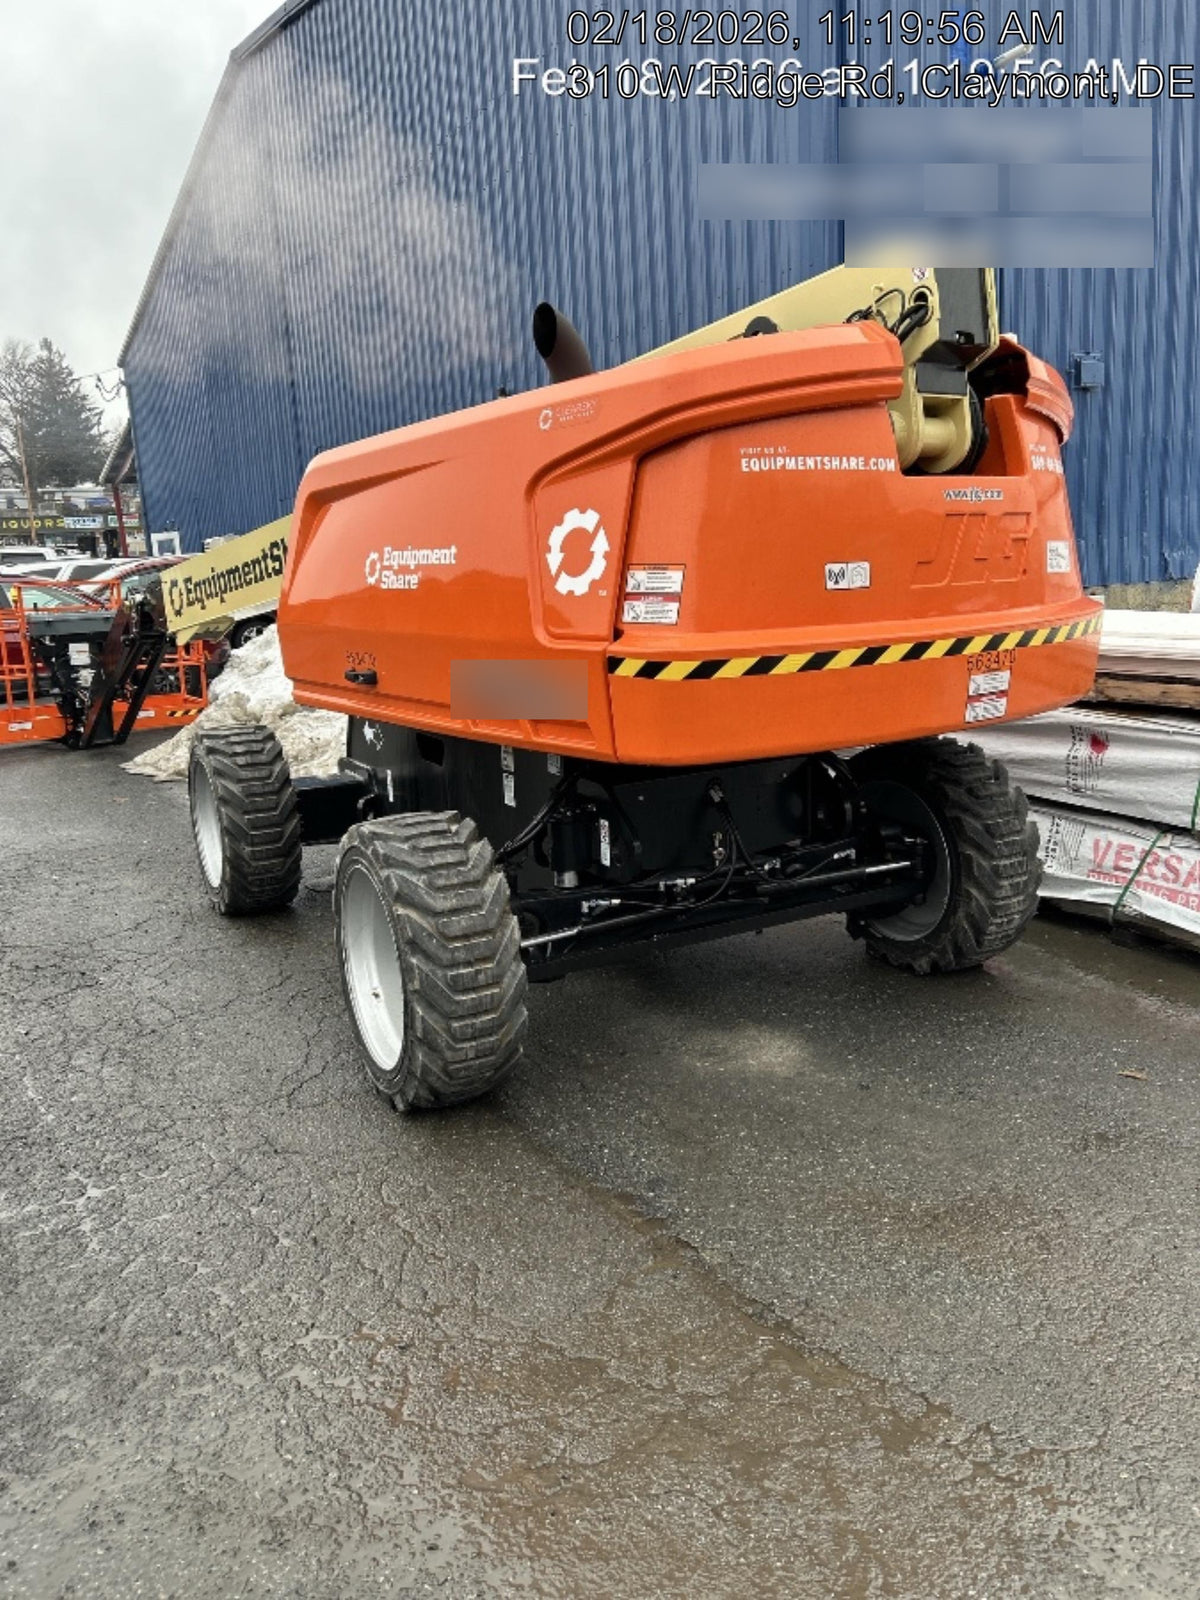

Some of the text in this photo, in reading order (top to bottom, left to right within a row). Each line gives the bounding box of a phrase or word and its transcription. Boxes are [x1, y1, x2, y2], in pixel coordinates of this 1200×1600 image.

[740, 456, 896, 472] EQUIPMENTSHARE.COM
[382, 545, 457, 570] Equipment
[380, 570, 419, 590] Share
